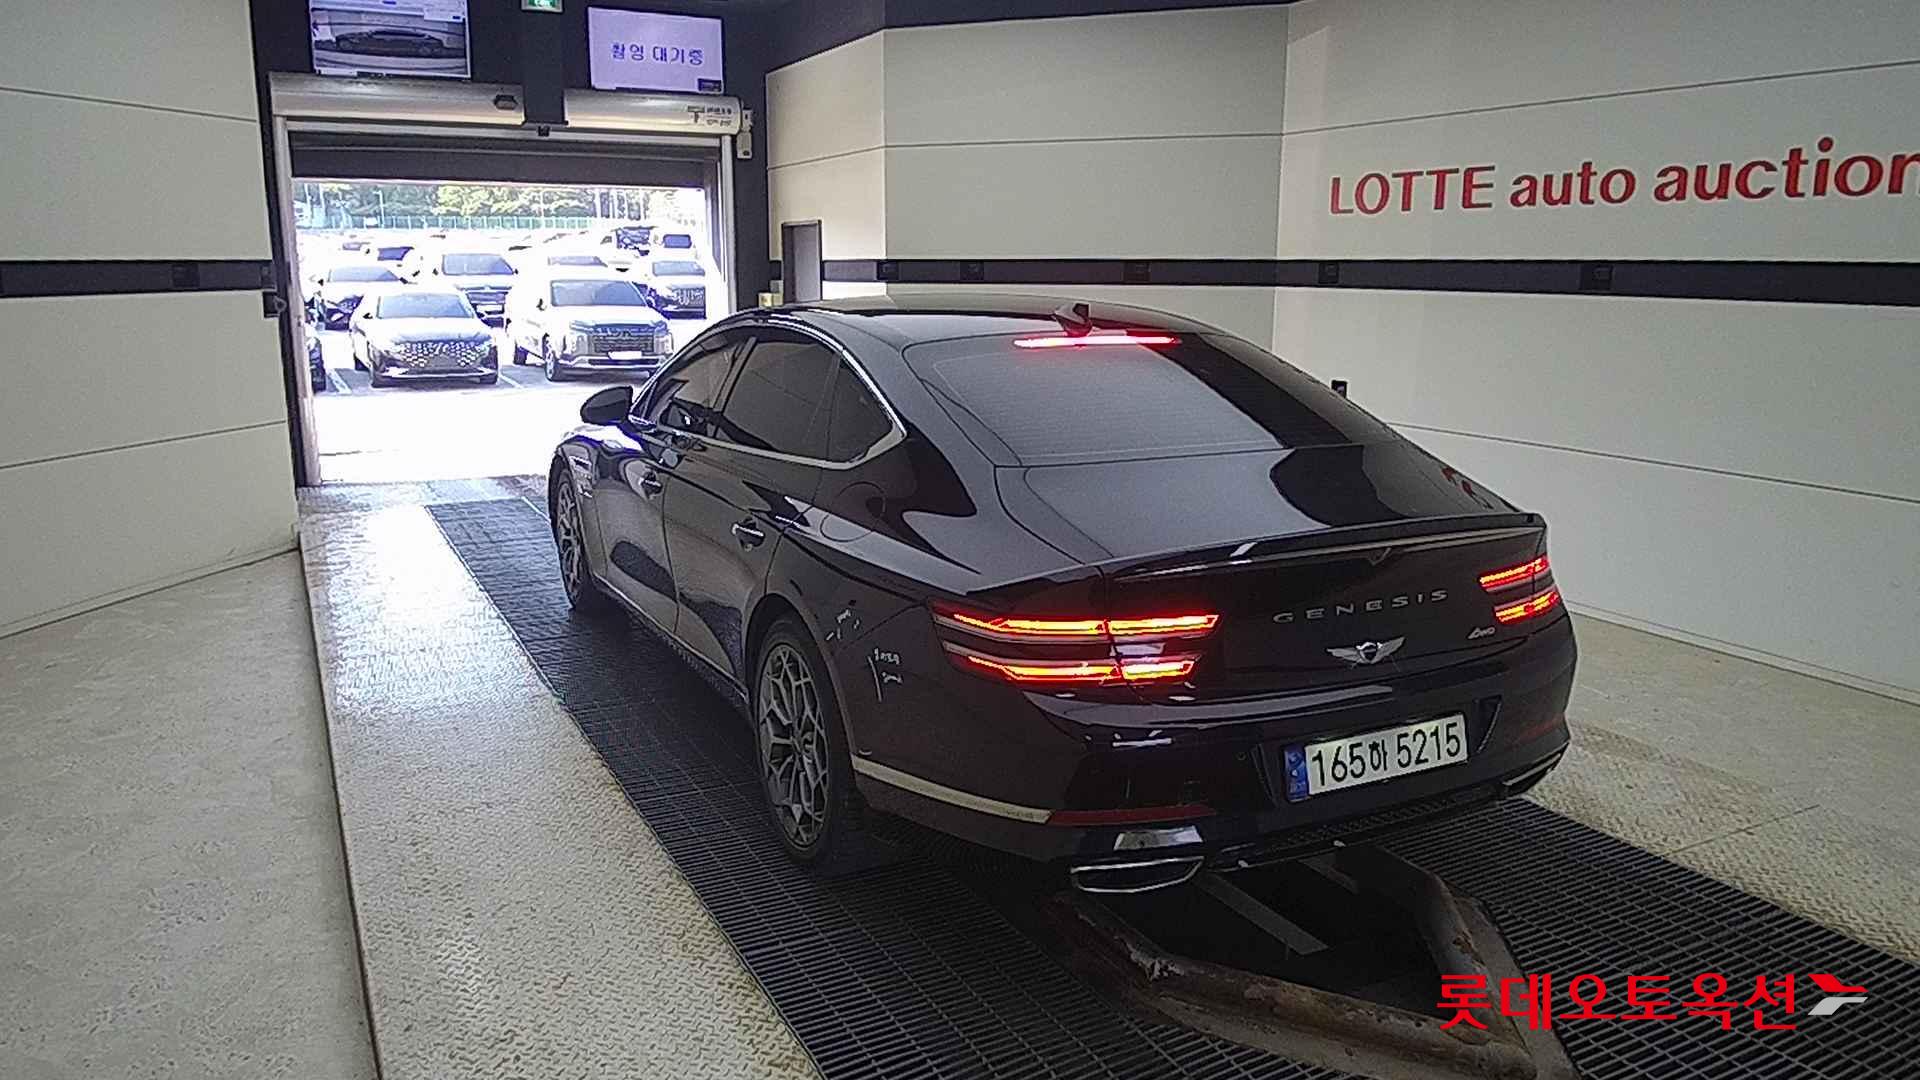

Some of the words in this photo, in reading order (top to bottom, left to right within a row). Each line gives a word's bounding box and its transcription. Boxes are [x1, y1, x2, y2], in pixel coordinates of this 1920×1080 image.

[652, 46, 703, 66] 대기중
[1330, 164, 1496, 215] LOTTE
[1509, 161, 1636, 208] auto
[1272, 589, 1449, 624] GENESIS
[1311, 739, 1388, 787] 165하
[1396, 722, 1461, 768] 5215
